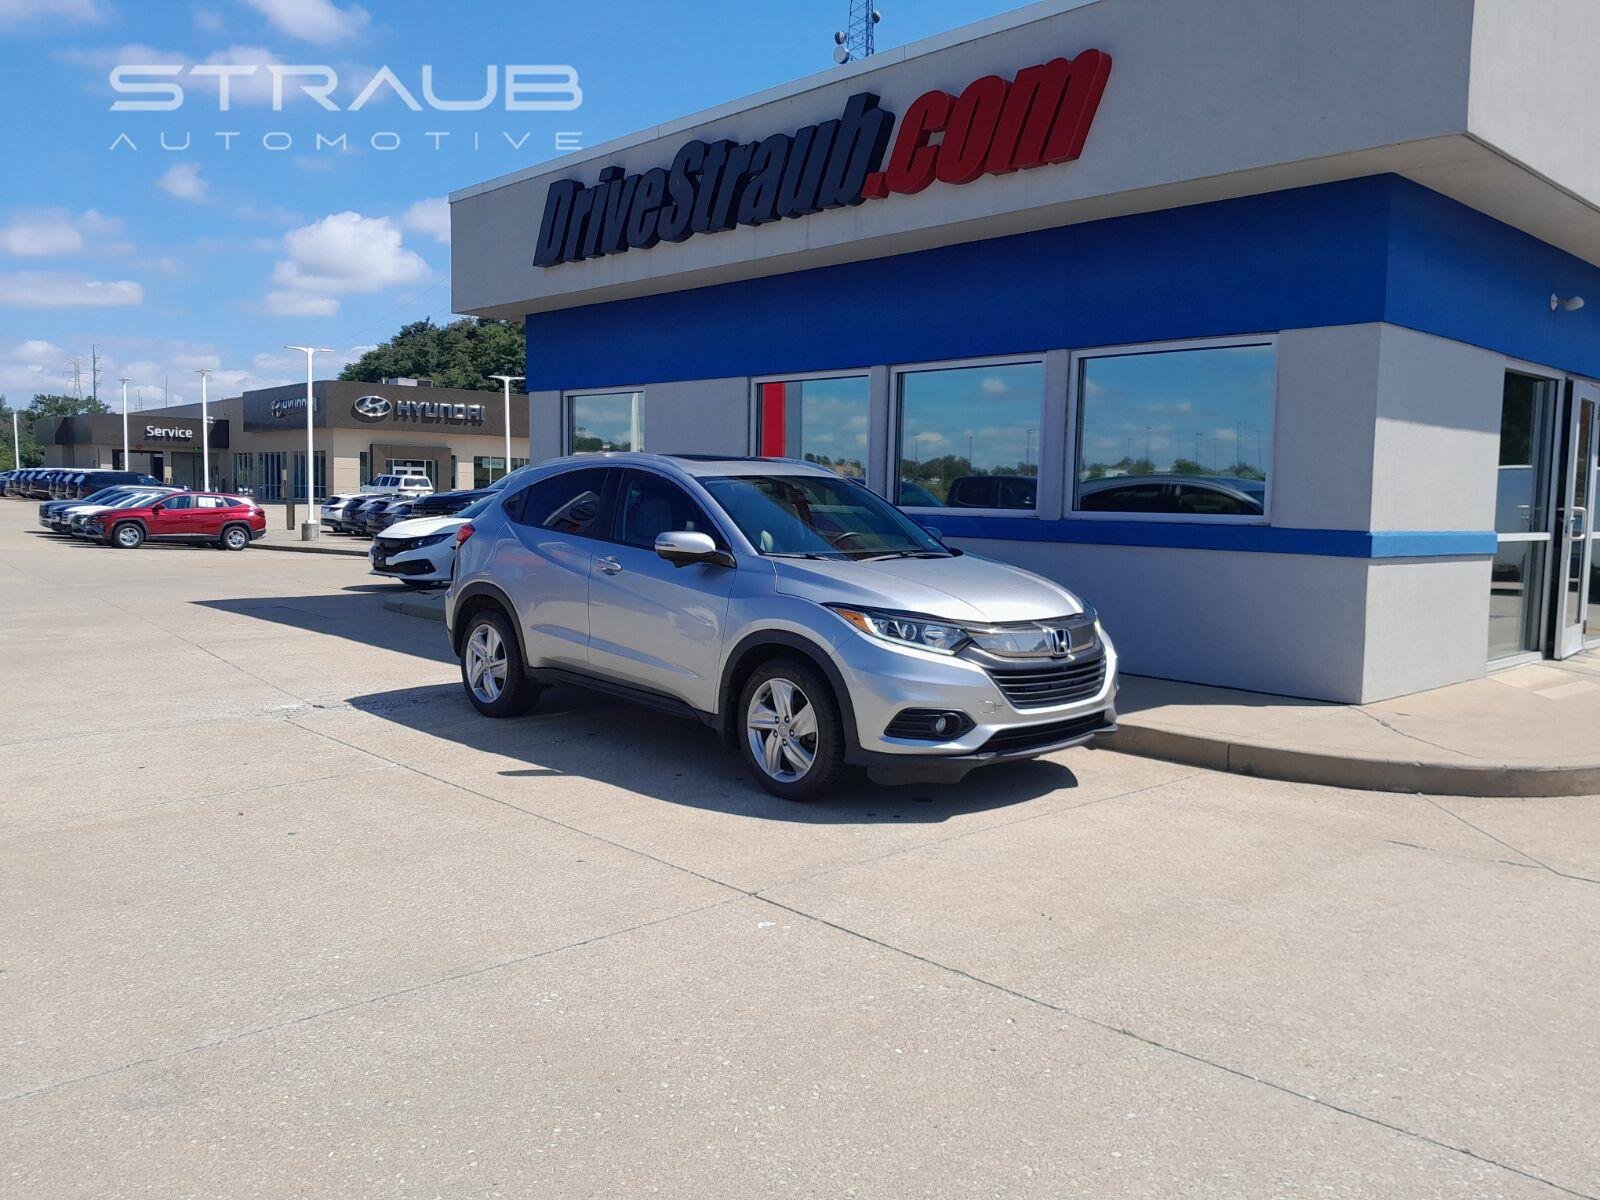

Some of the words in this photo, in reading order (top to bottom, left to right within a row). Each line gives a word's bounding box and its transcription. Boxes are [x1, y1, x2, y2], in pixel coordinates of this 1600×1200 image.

[533, 49, 1112, 267] DriveStraub.com
[396, 400, 486, 420] HYUNDAI
[145, 425, 193, 438] Service
